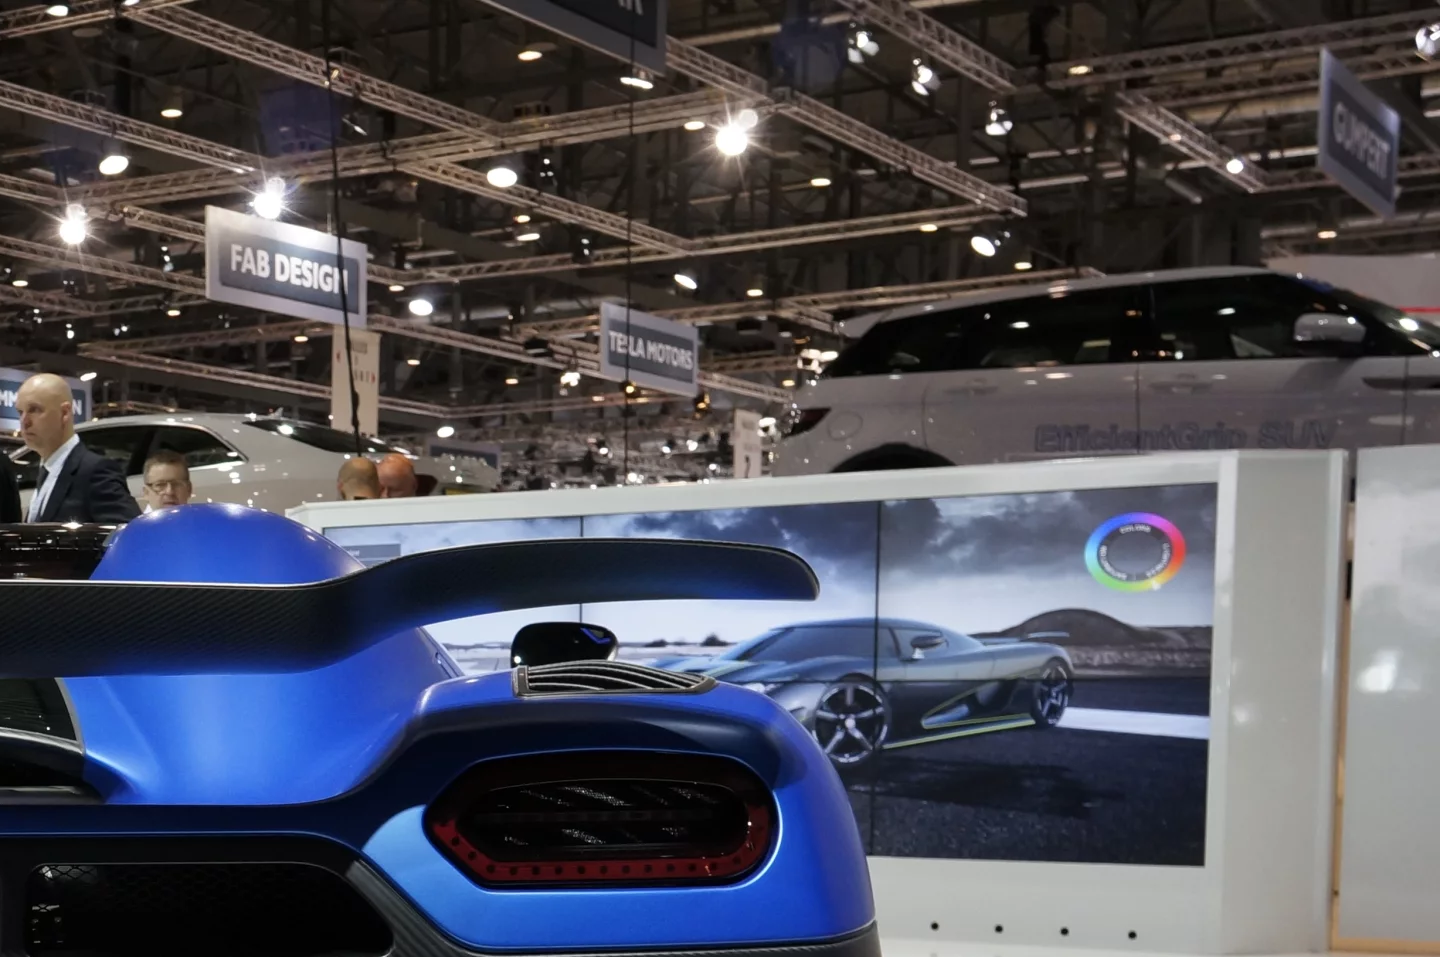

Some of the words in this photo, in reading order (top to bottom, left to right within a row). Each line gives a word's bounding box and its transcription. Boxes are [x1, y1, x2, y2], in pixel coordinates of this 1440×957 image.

[230, 243, 271, 279] FAB
[274, 253, 349, 296] DESIGN
[646, 340, 694, 371] MOTORS
[1257, 418, 1337, 449] SUV
